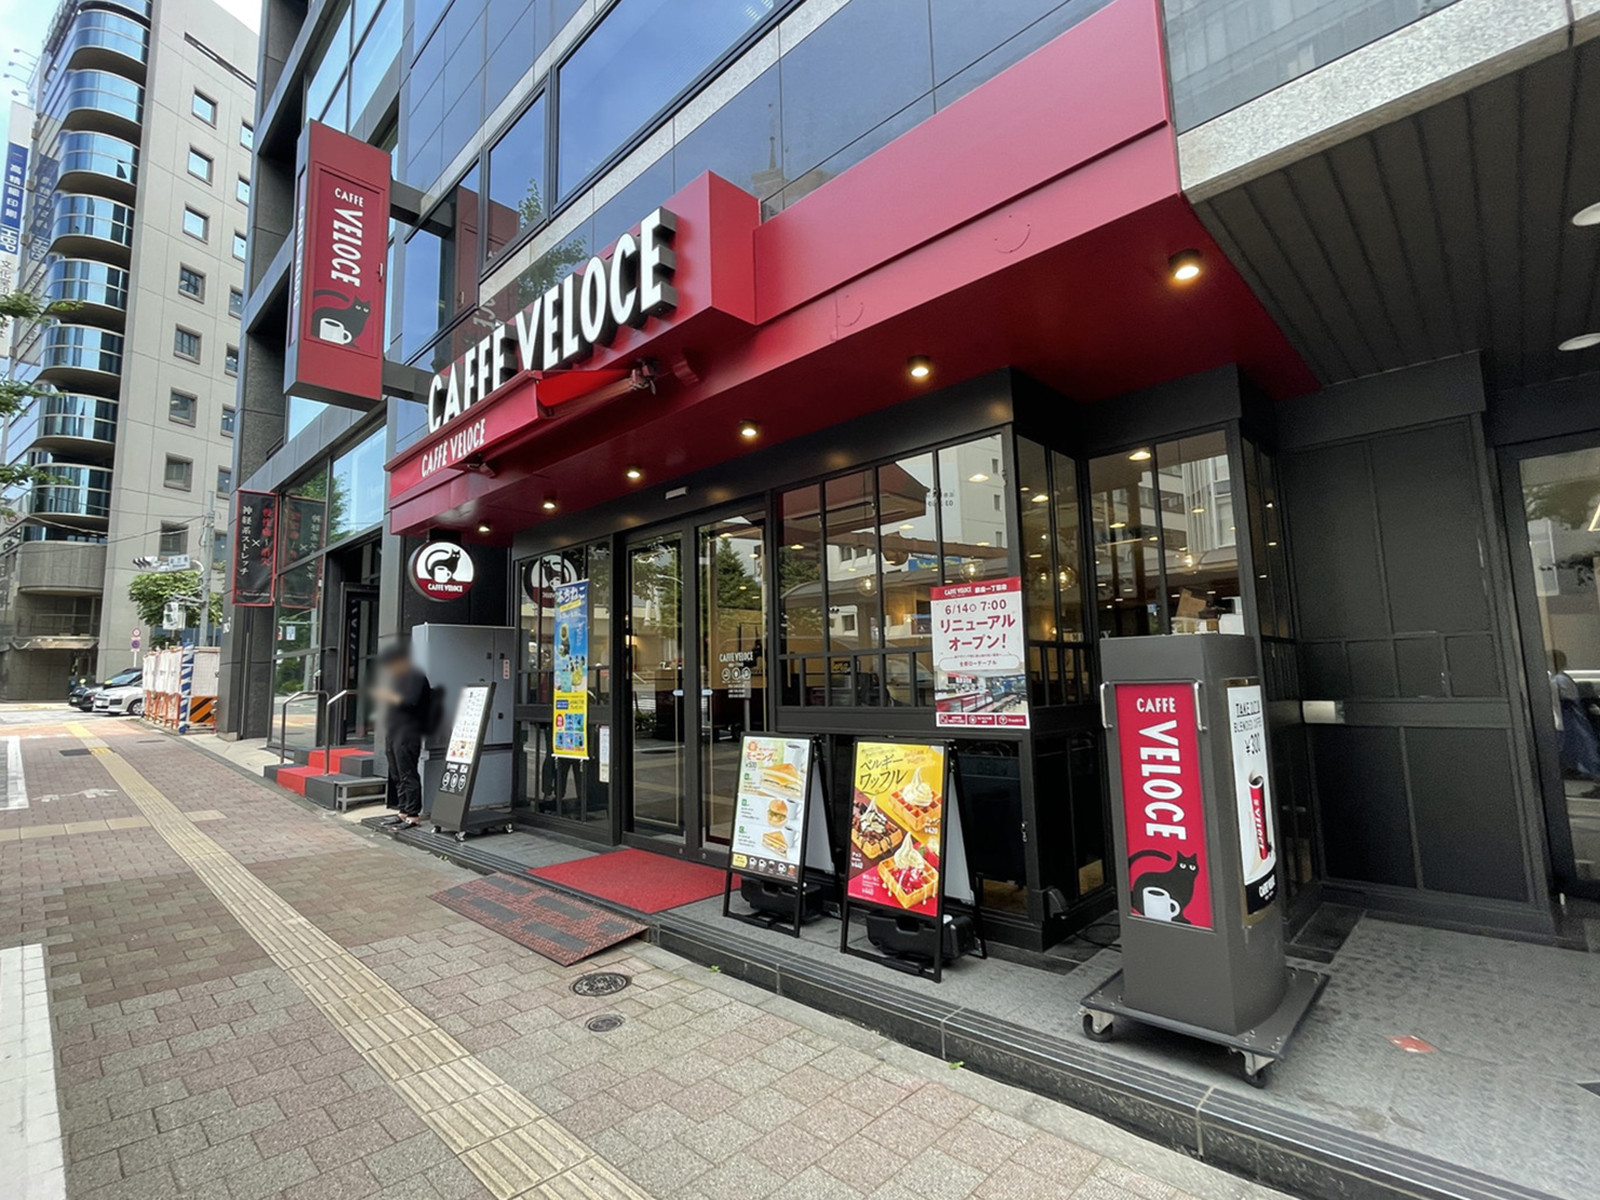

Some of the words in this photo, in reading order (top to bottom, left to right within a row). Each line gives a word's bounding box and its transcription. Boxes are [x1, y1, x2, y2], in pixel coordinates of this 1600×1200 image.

[331, 208, 364, 288] VELOCE
[514, 206, 663, 371] VELOCE
[449, 418, 486, 461] VELOCE
[980, 598, 1007, 611] 7:00
[940, 613, 1016, 634] リニューアル
[860, 753, 904, 770] ベルギー
[860, 769, 909, 794] ワッフル
[1138, 720, 1187, 841] VELOCE
